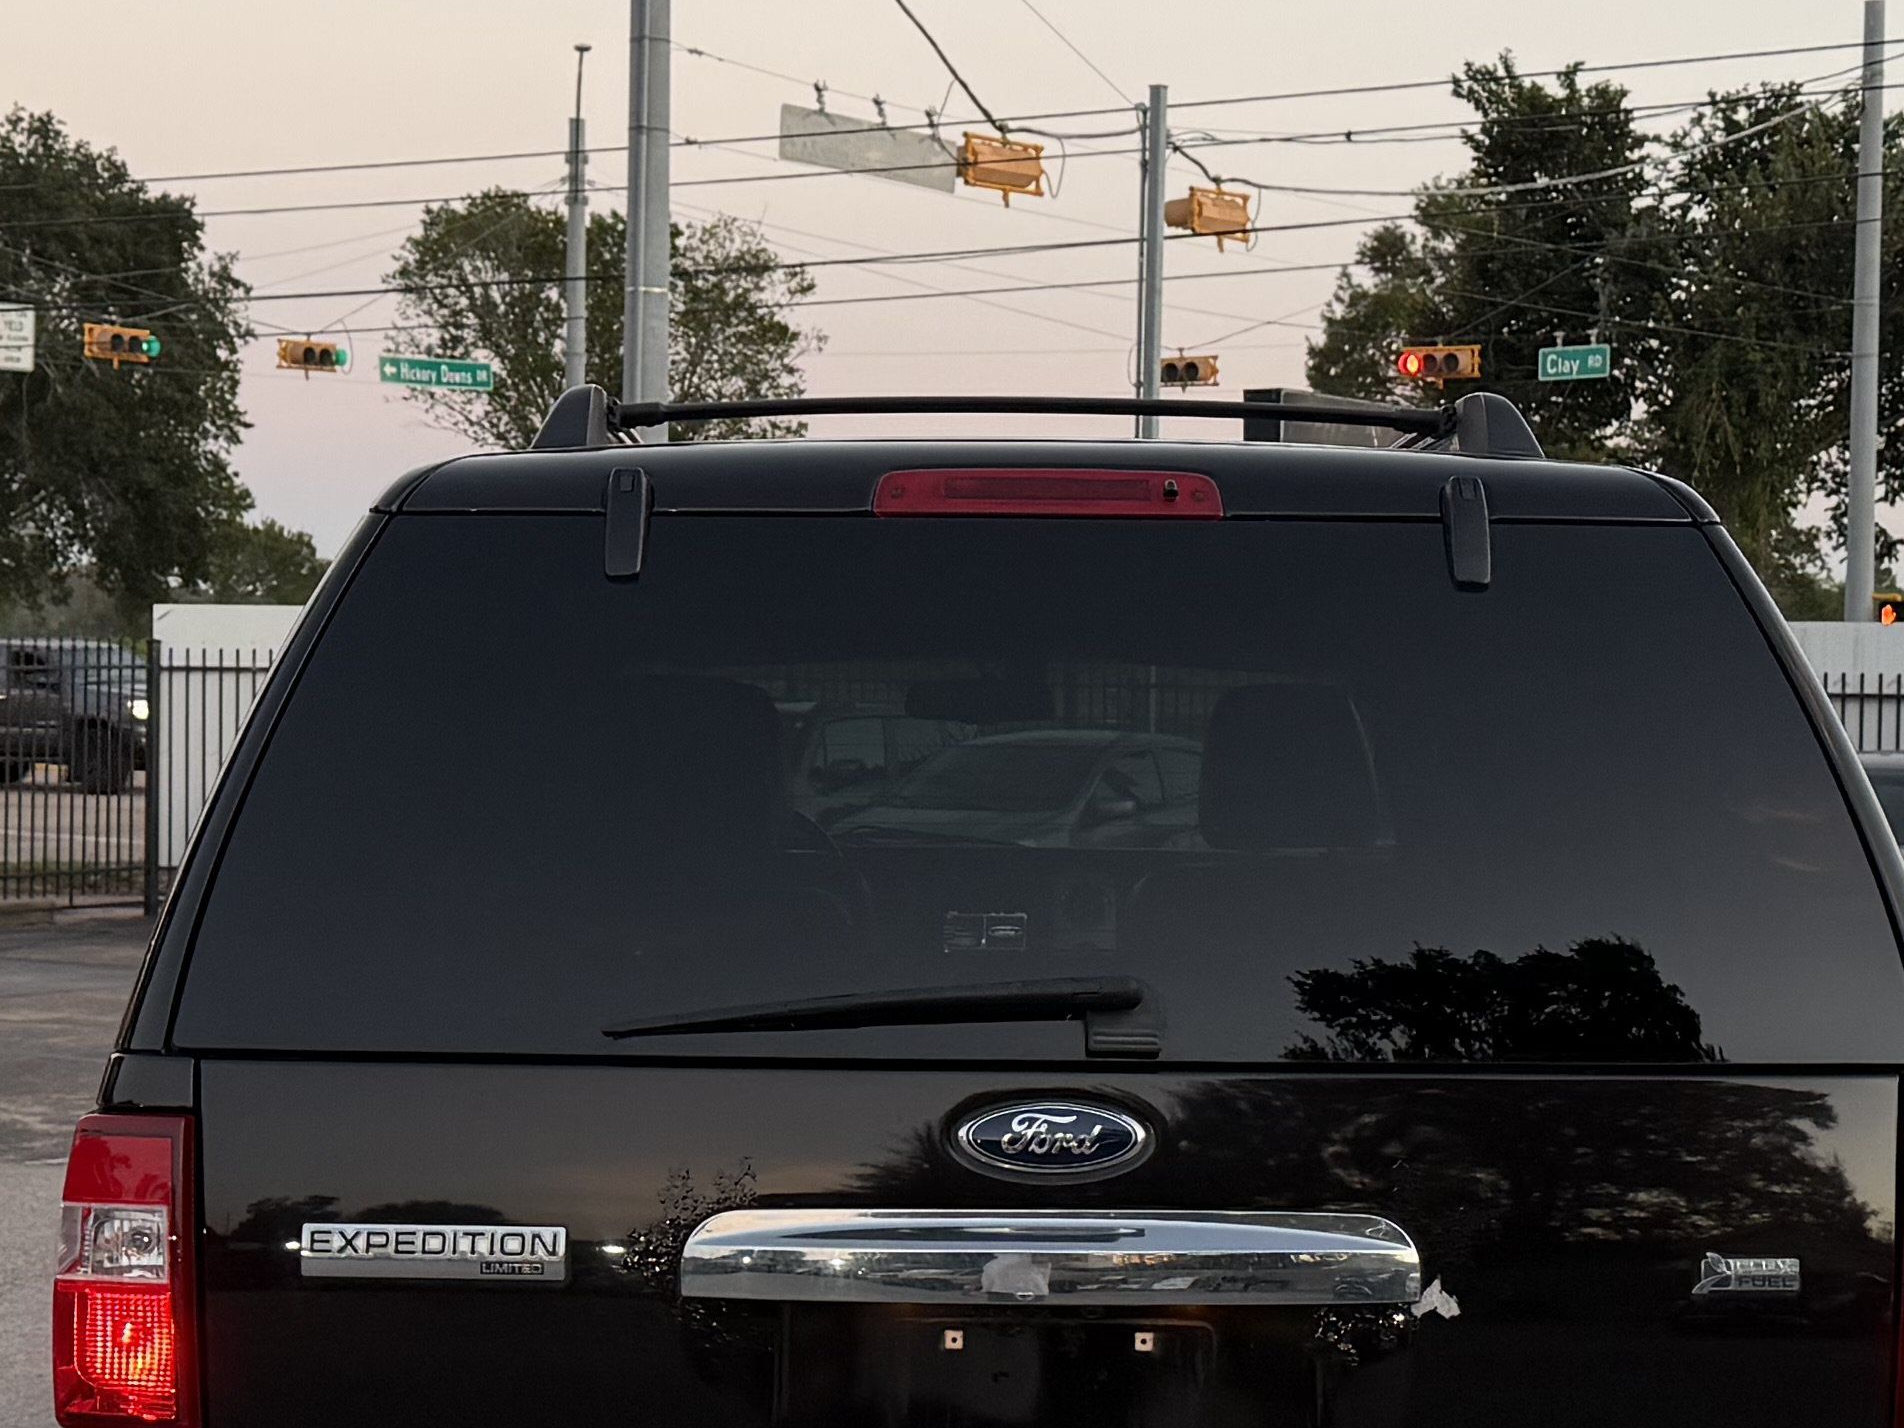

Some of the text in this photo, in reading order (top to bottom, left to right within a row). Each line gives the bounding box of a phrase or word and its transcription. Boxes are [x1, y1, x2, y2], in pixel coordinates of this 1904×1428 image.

[400, 362, 436, 385] Hickory
[1546, 353, 1603, 377] Clay RD
[1000, 1113, 1103, 1155] Ford
[309, 1229, 558, 1257] EXPEDITION
[481, 1262, 542, 1274] LIMITED
[1737, 1276, 1796, 1288] FUEL
